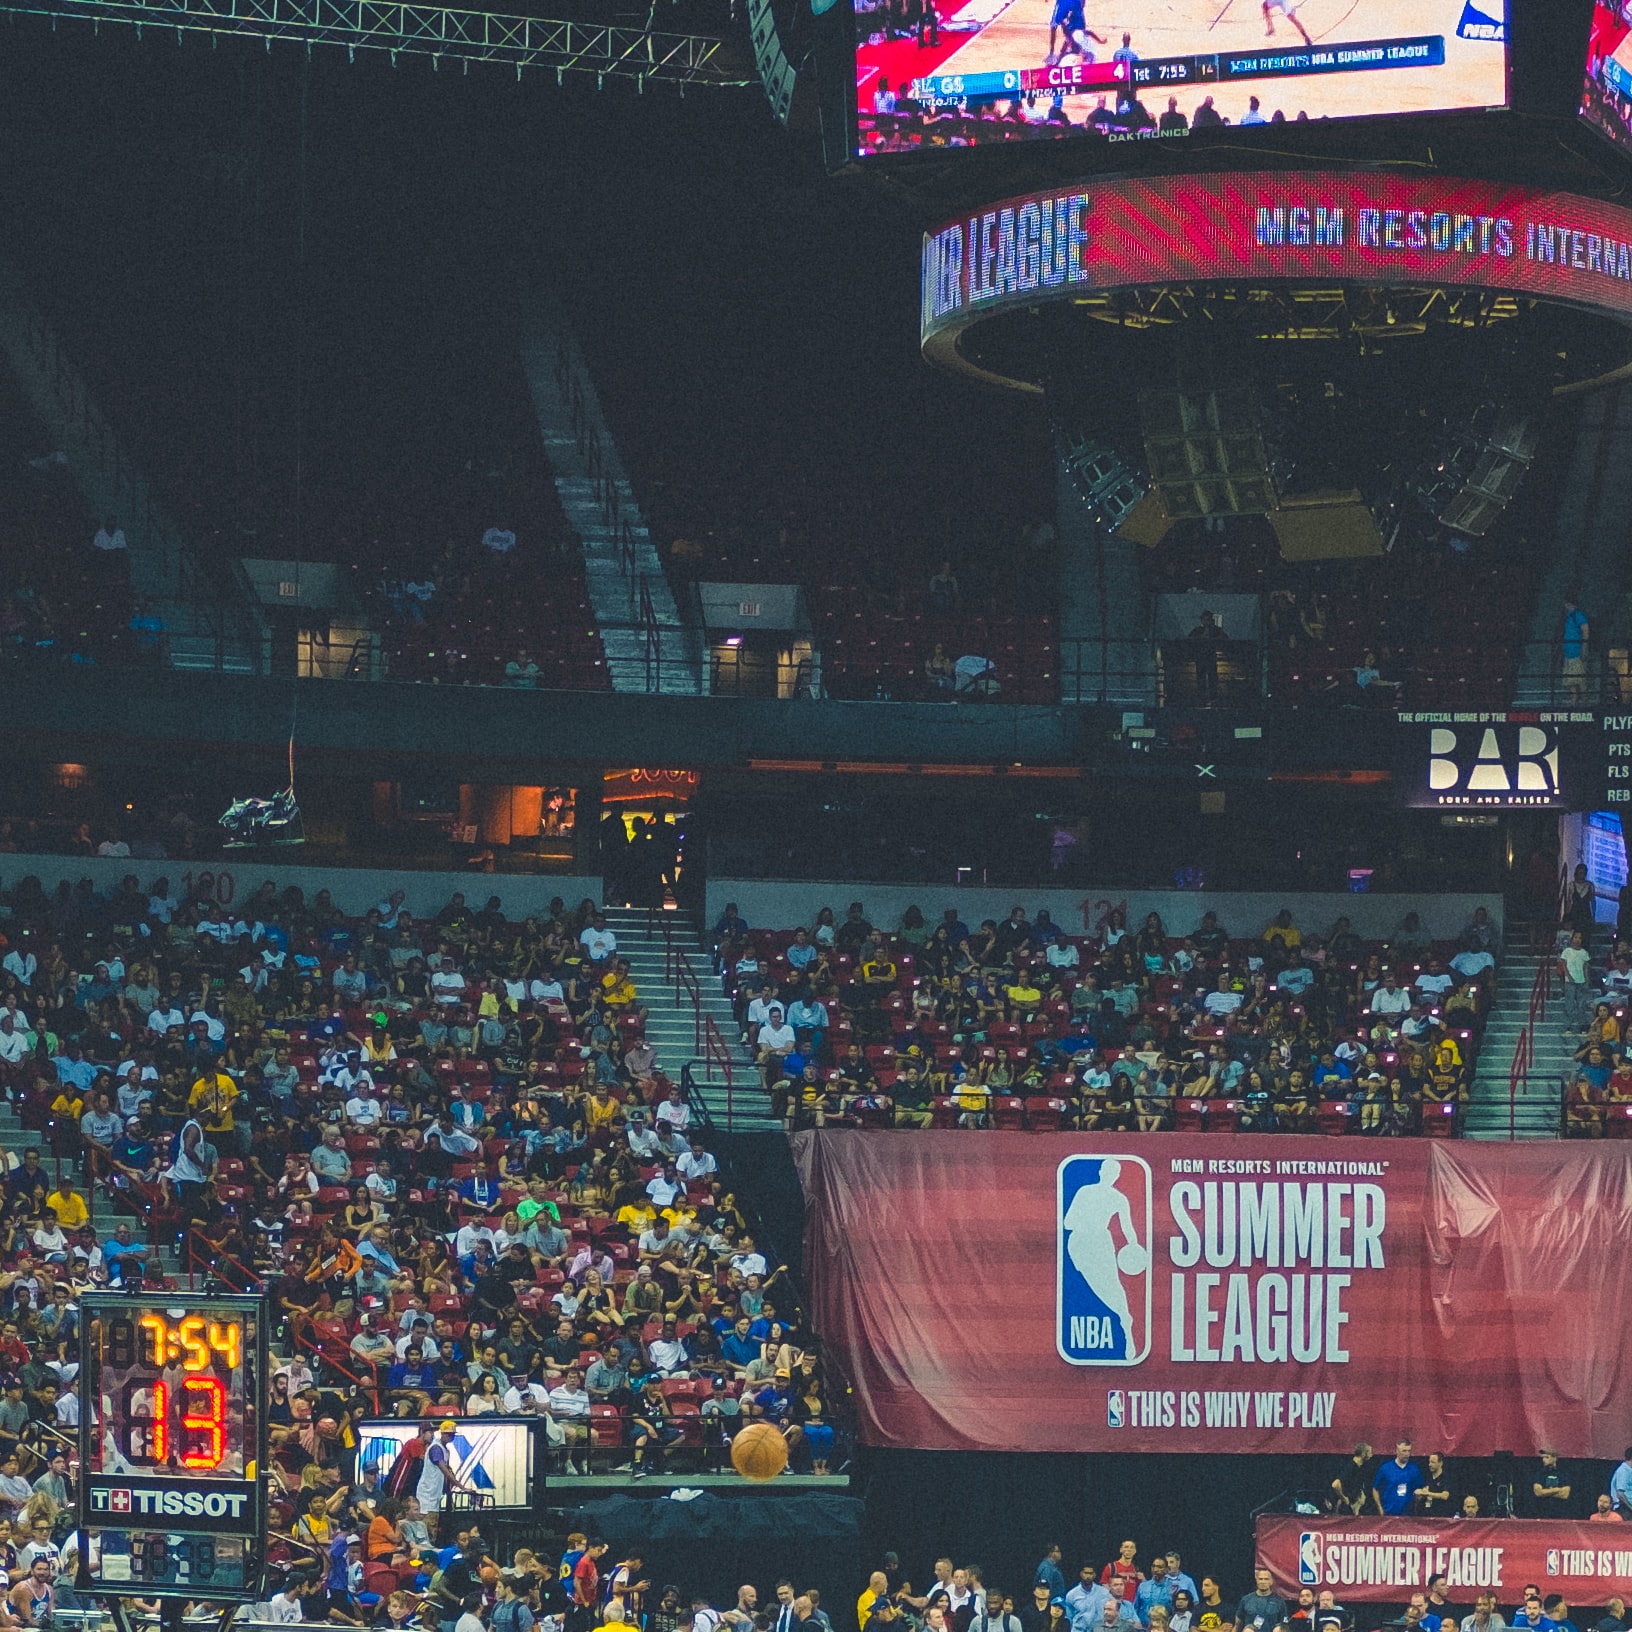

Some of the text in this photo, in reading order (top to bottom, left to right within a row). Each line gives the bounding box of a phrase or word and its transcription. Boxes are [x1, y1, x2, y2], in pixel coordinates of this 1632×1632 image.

[1048, 66, 1082, 84] CLE
[1108, 127, 1190, 143] DAKTRONICS
[968, 192, 1089, 304] LEAGUE
[1256, 207, 1344, 246] MGM
[1358, 208, 1514, 257] RESORTS
[1609, 744, 1630, 755] PTS
[1608, 766, 1629, 778] FLS
[1608, 789, 1631, 801] REB
[1171, 1160, 1272, 1176] MGM RESORTS
[1170, 1181, 1386, 1271] SUMMER
[1070, 1315, 1114, 1351] NBA
[1170, 1273, 1350, 1366] LEAGUE
[141, 1314, 241, 1372] 7:54
[153, 1376, 226, 1470] 13
[1129, 1390, 1337, 1430] THIS IS WHY WE PLAY
[132, 1489, 247, 1518] TISSOT
[1325, 1546, 1504, 1587] SUMMER LEAGUE
[1561, 1549, 1594, 1577] THIS
[1596, 1550, 1612, 1577] IS
